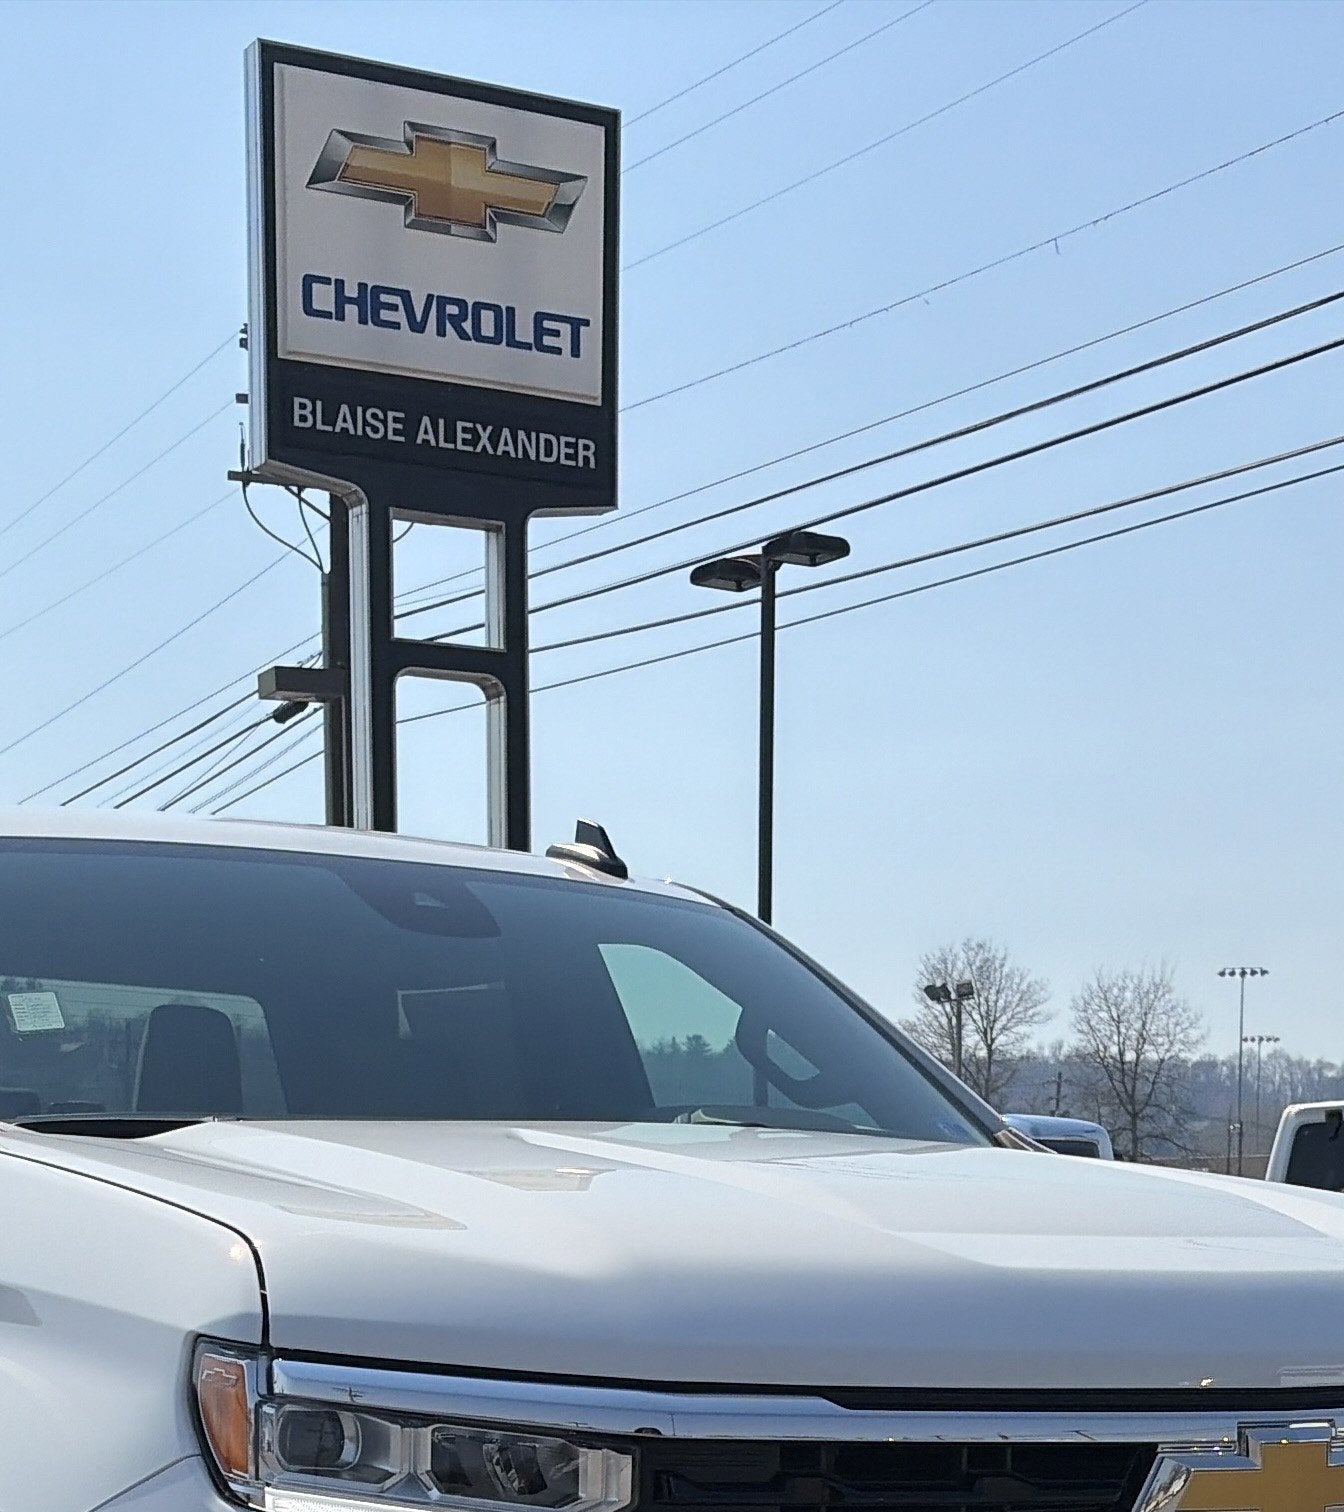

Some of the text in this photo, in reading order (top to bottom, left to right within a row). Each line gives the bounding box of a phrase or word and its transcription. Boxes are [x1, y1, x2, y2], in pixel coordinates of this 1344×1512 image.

[302, 273, 590, 359] CHEVROLET
[293, 396, 597, 470] BLAISE ALEXANDER
